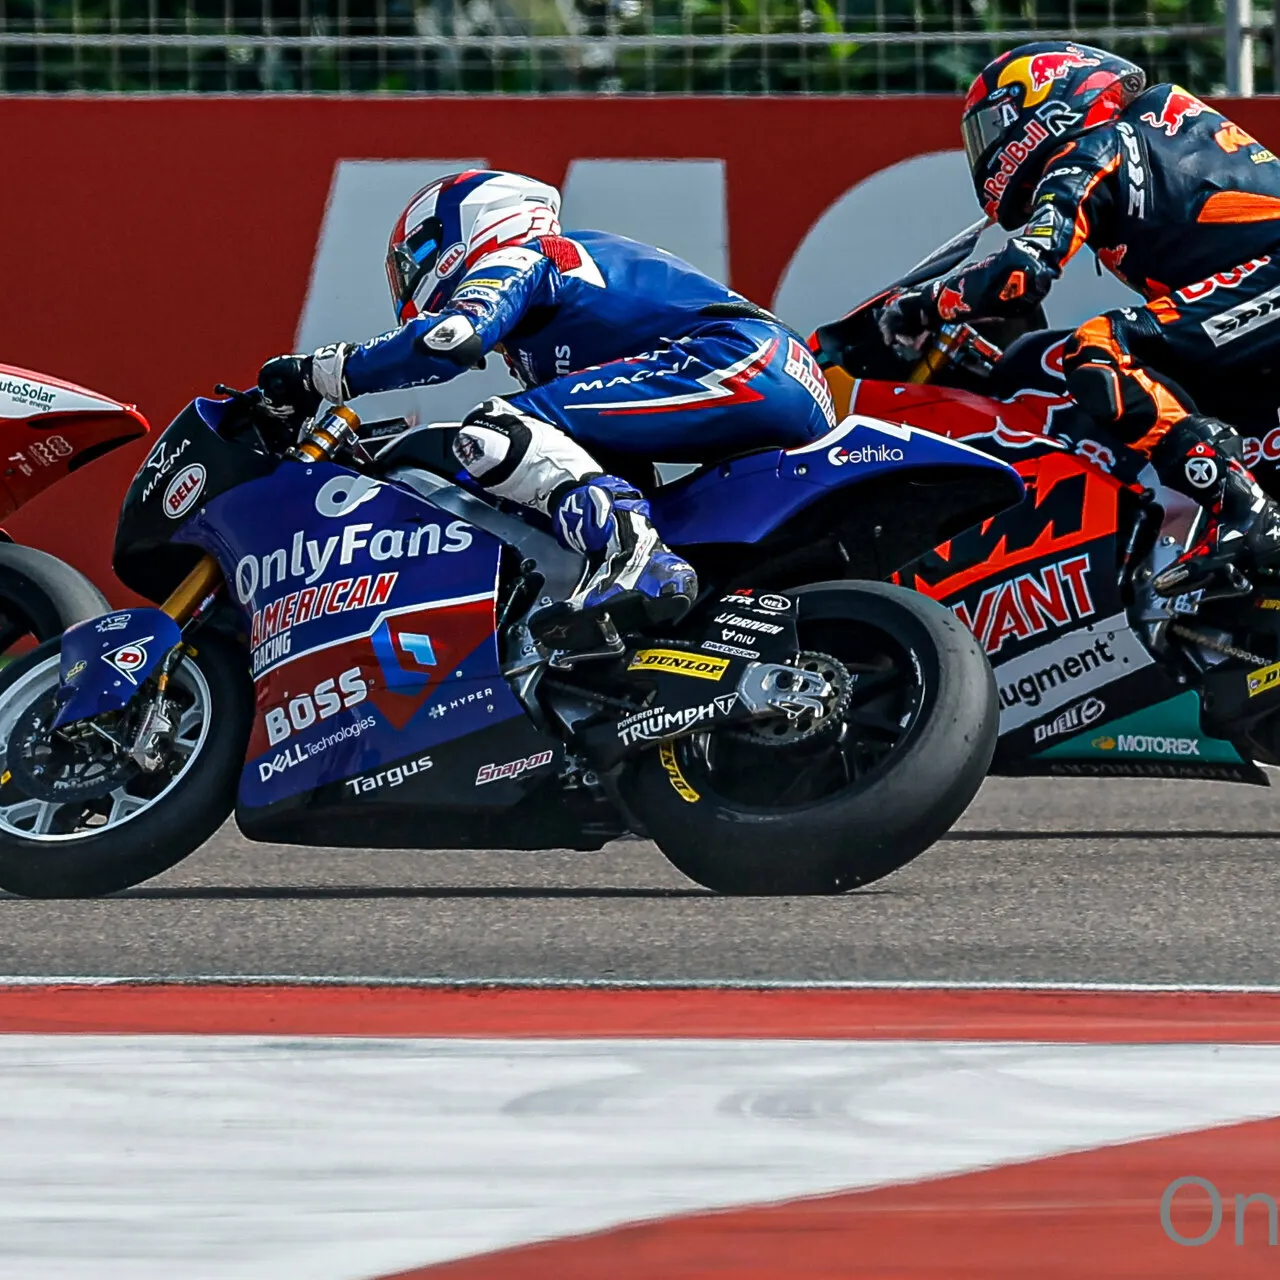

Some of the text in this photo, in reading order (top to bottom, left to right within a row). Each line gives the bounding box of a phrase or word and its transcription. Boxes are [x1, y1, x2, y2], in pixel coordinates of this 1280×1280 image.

[438, 247, 465, 275] BELL
[142, 438, 192, 503] MAGNA
[848, 444, 904, 463] ethika
[168, 472, 202, 513] BELL
[235, 520, 474, 605] OnlyFans
[251, 571, 400, 652] AMERICAN
[252, 631, 292, 676] RACING
[645, 655, 725, 674] DUNLOP
[265, 666, 370, 748] BOSS
[449, 687, 494, 712] HYPER
[617, 702, 715, 747] TRIUMPH
[1117, 733, 1201, 756] MOTOREX
[258, 714, 377, 783] DELL Technologies
[474, 749, 554, 787] Snap-on
[345, 754, 434, 797] Targus
